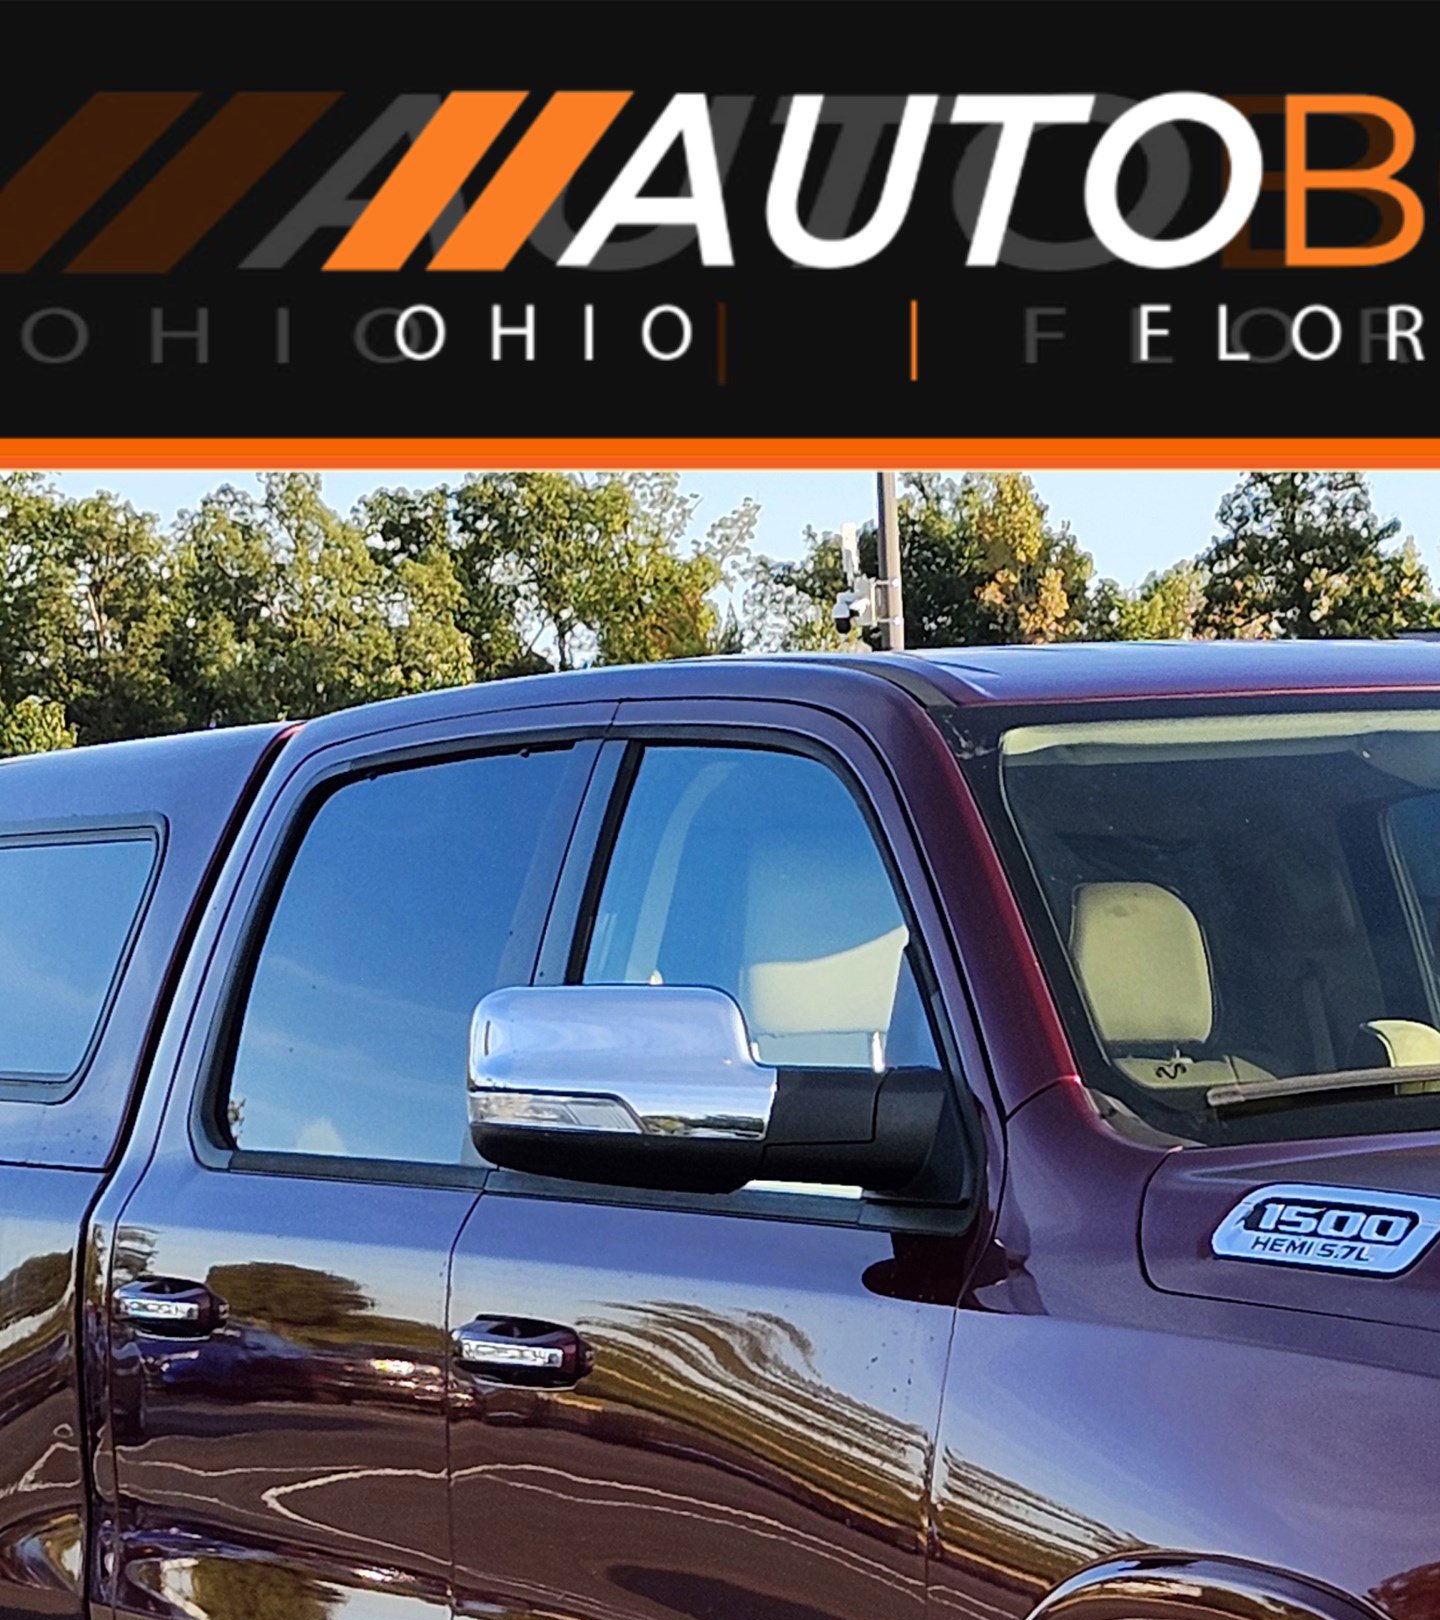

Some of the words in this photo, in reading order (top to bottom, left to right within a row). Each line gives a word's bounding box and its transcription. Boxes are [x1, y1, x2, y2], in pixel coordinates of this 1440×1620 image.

[1257, 1203, 1412, 1242] 1500
[1250, 1235, 1312, 1257] HEMI
[1315, 1242, 1370, 1262] 5.7L
